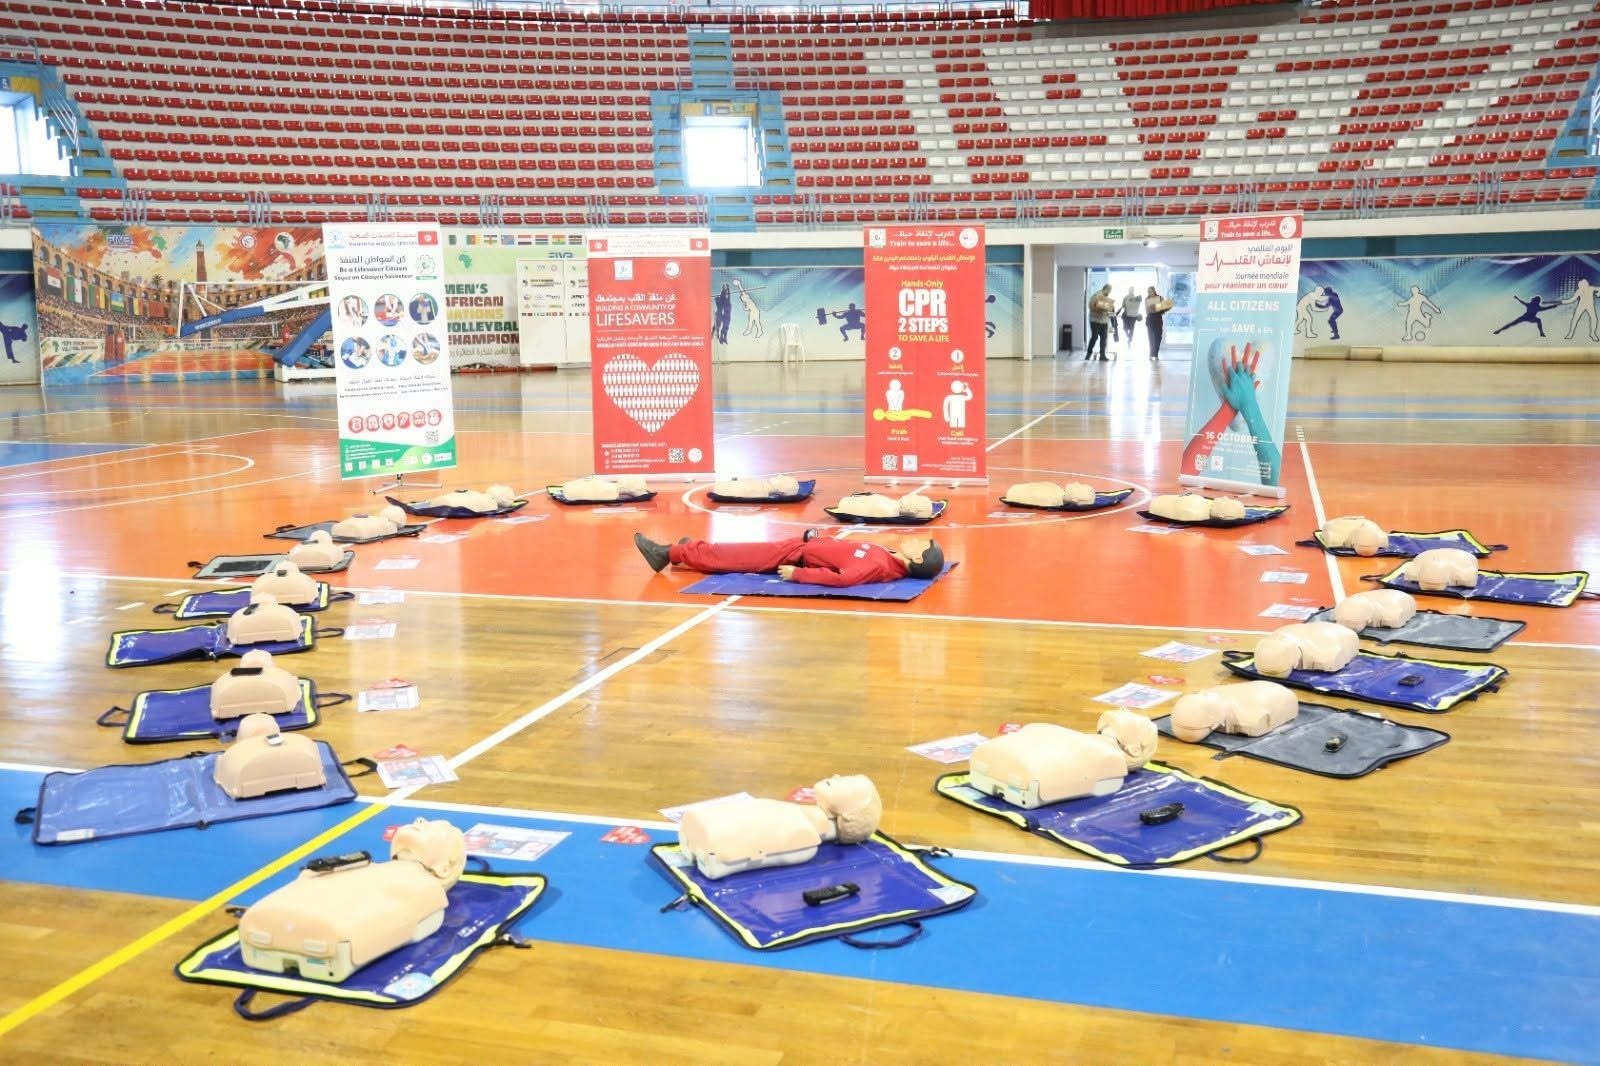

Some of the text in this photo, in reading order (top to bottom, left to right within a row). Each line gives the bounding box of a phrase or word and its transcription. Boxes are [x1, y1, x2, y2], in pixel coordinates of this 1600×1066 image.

[901, 280, 943, 289] Hands-Only
[898, 288, 947, 317] CPR
[1208, 300, 1280, 311] ALL CITIZENS
[596, 313, 674, 326] LIFESAVERS
[898, 318, 948, 333] 2 STEPS
[1232, 324, 1256, 333] SAVE
[1217, 432, 1258, 444] OCTOBRE
